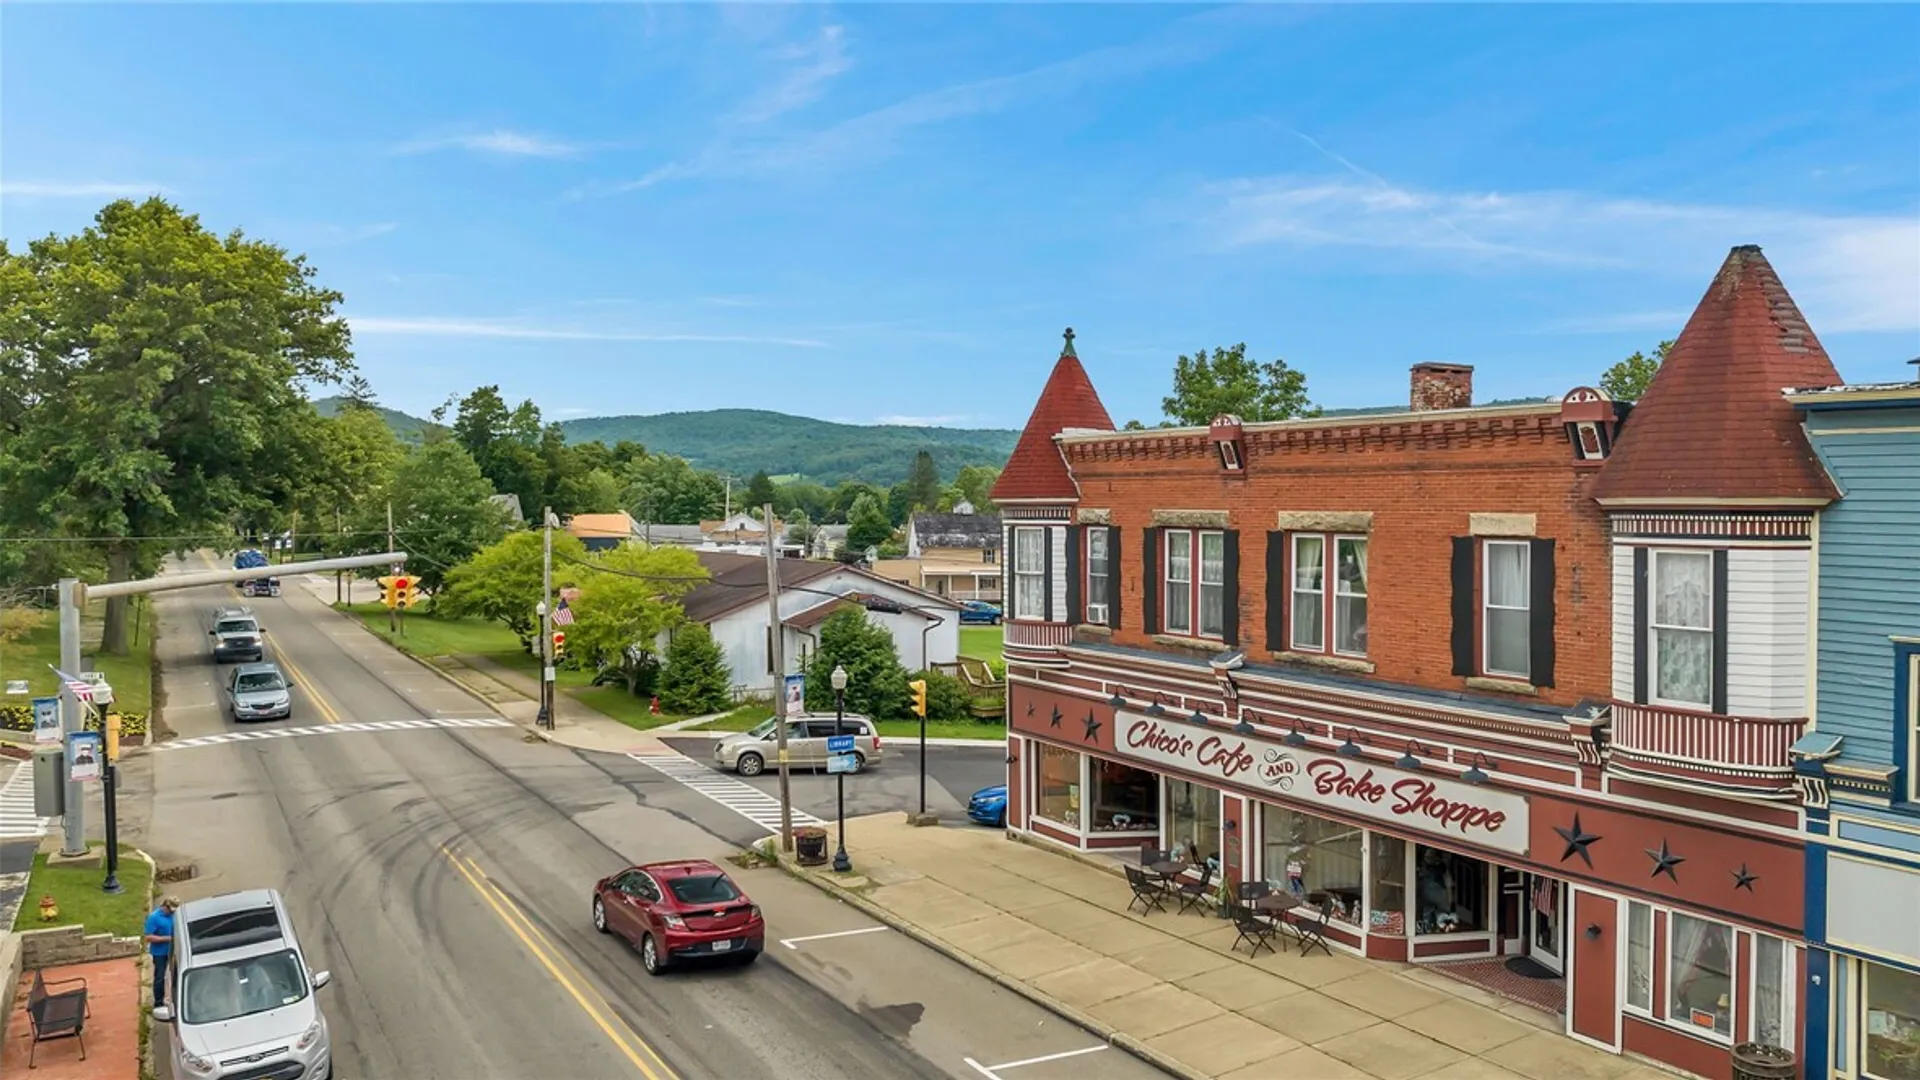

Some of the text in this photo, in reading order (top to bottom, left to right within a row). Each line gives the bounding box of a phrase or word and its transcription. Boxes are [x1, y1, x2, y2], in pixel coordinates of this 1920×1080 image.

[1127, 720, 1507, 833] Chico's Cafe AND Bake Shoppe
